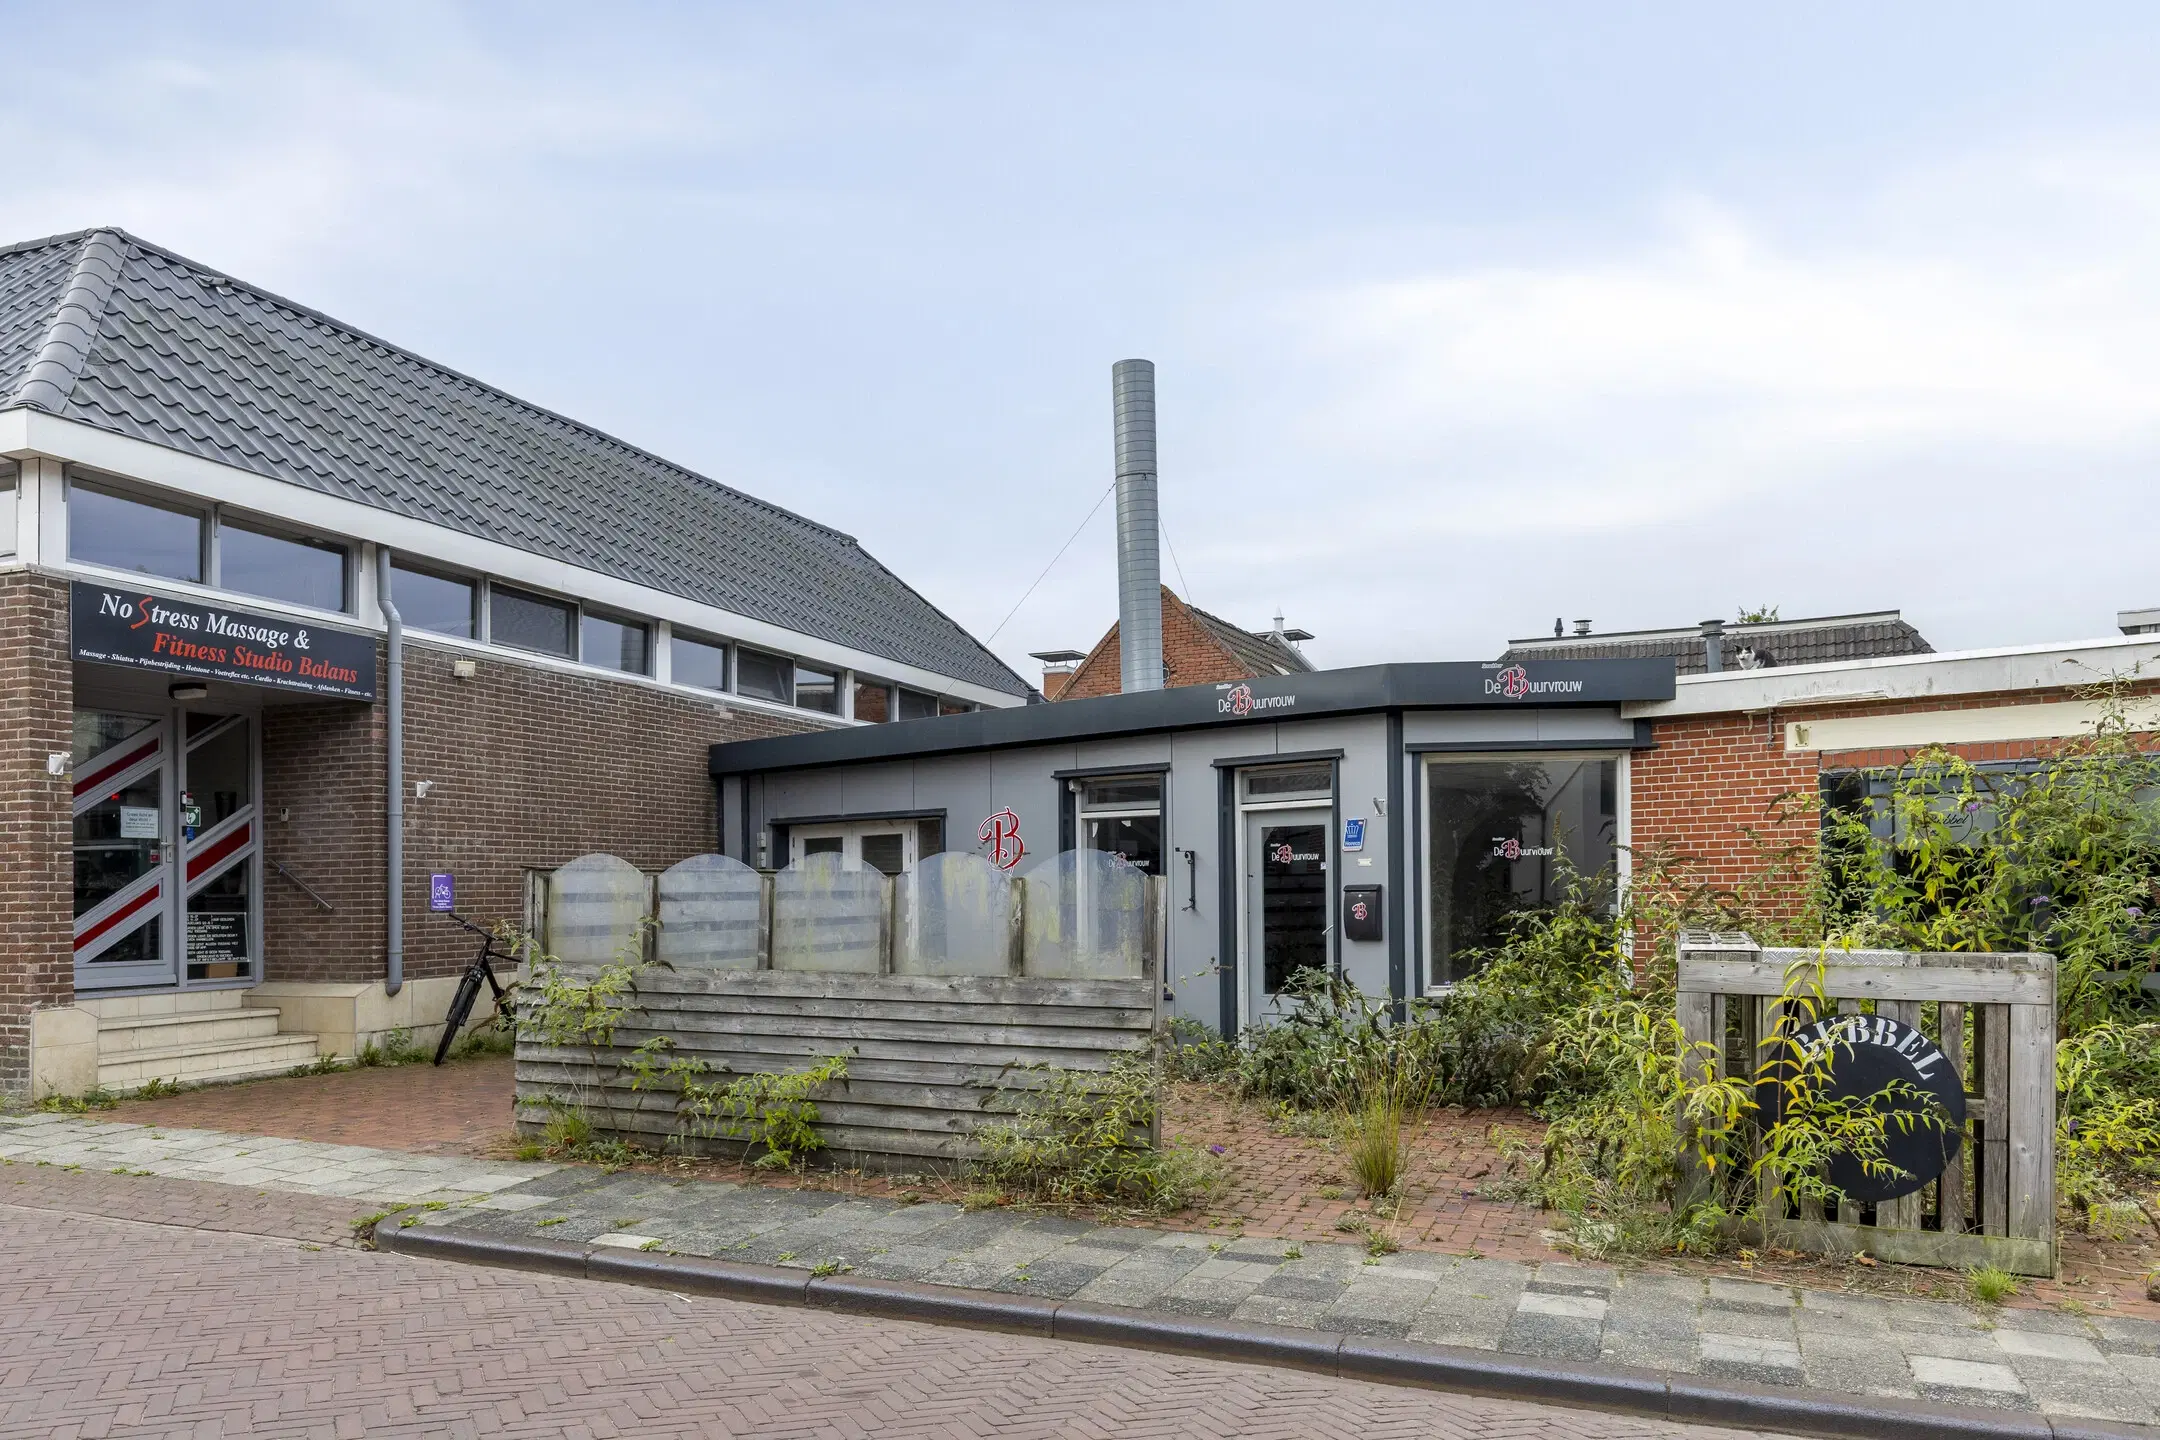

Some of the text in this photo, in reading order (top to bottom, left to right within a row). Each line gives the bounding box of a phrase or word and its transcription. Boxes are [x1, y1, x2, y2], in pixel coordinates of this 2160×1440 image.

[100, 593, 310, 650] No Stress Massage &
[79, 649, 106, 659] Massage
[111, 653, 134, 663] Shiatsu
[185, 664, 210, 674] Hotstone
[254, 674, 273, 683] Cardio
[153, 632, 357, 683] Fitness Studio Balans
[1485, 664, 1582, 699] De Buurvrouw
[1218, 683, 1296, 716] De Buurvrouw
[978, 806, 1025, 876] B
[1271, 852, 1280, 861] De
[1493, 846, 1504, 856] De
